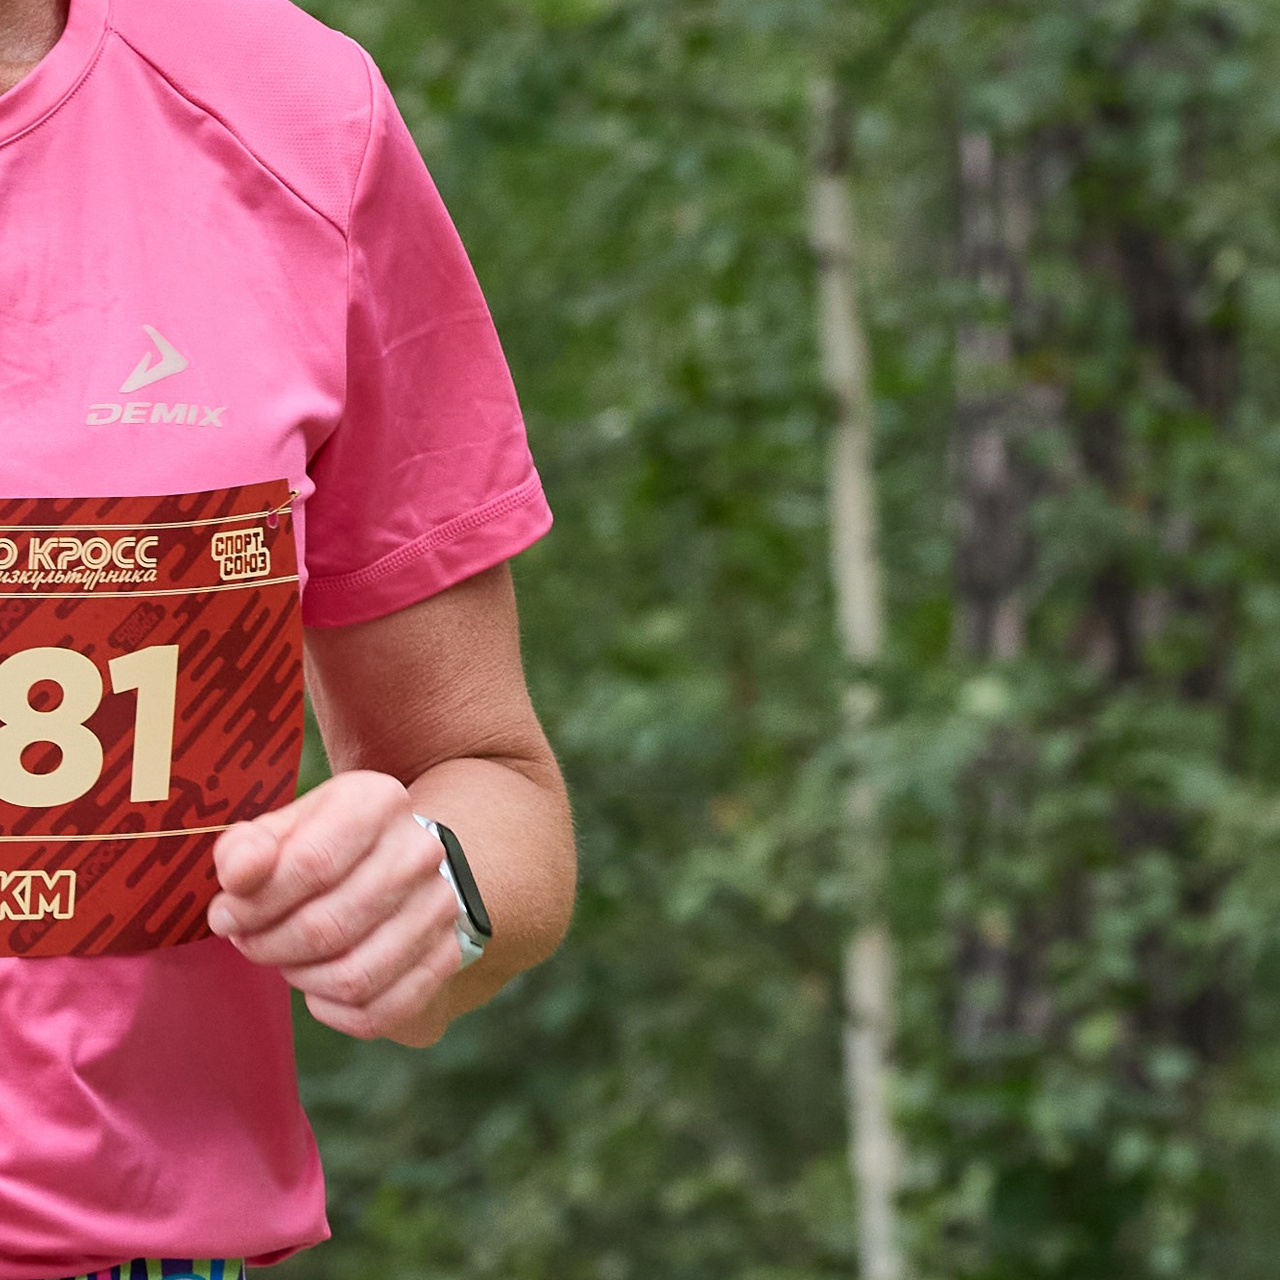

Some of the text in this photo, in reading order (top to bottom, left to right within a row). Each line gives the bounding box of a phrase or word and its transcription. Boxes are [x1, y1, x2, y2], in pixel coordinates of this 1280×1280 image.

[86, 402, 227, 428] DEMIX
[28, 536, 159, 570] КРОСС
[214, 532, 262, 557] СПОРТ
[223, 551, 267, 576] СОЮЗ
